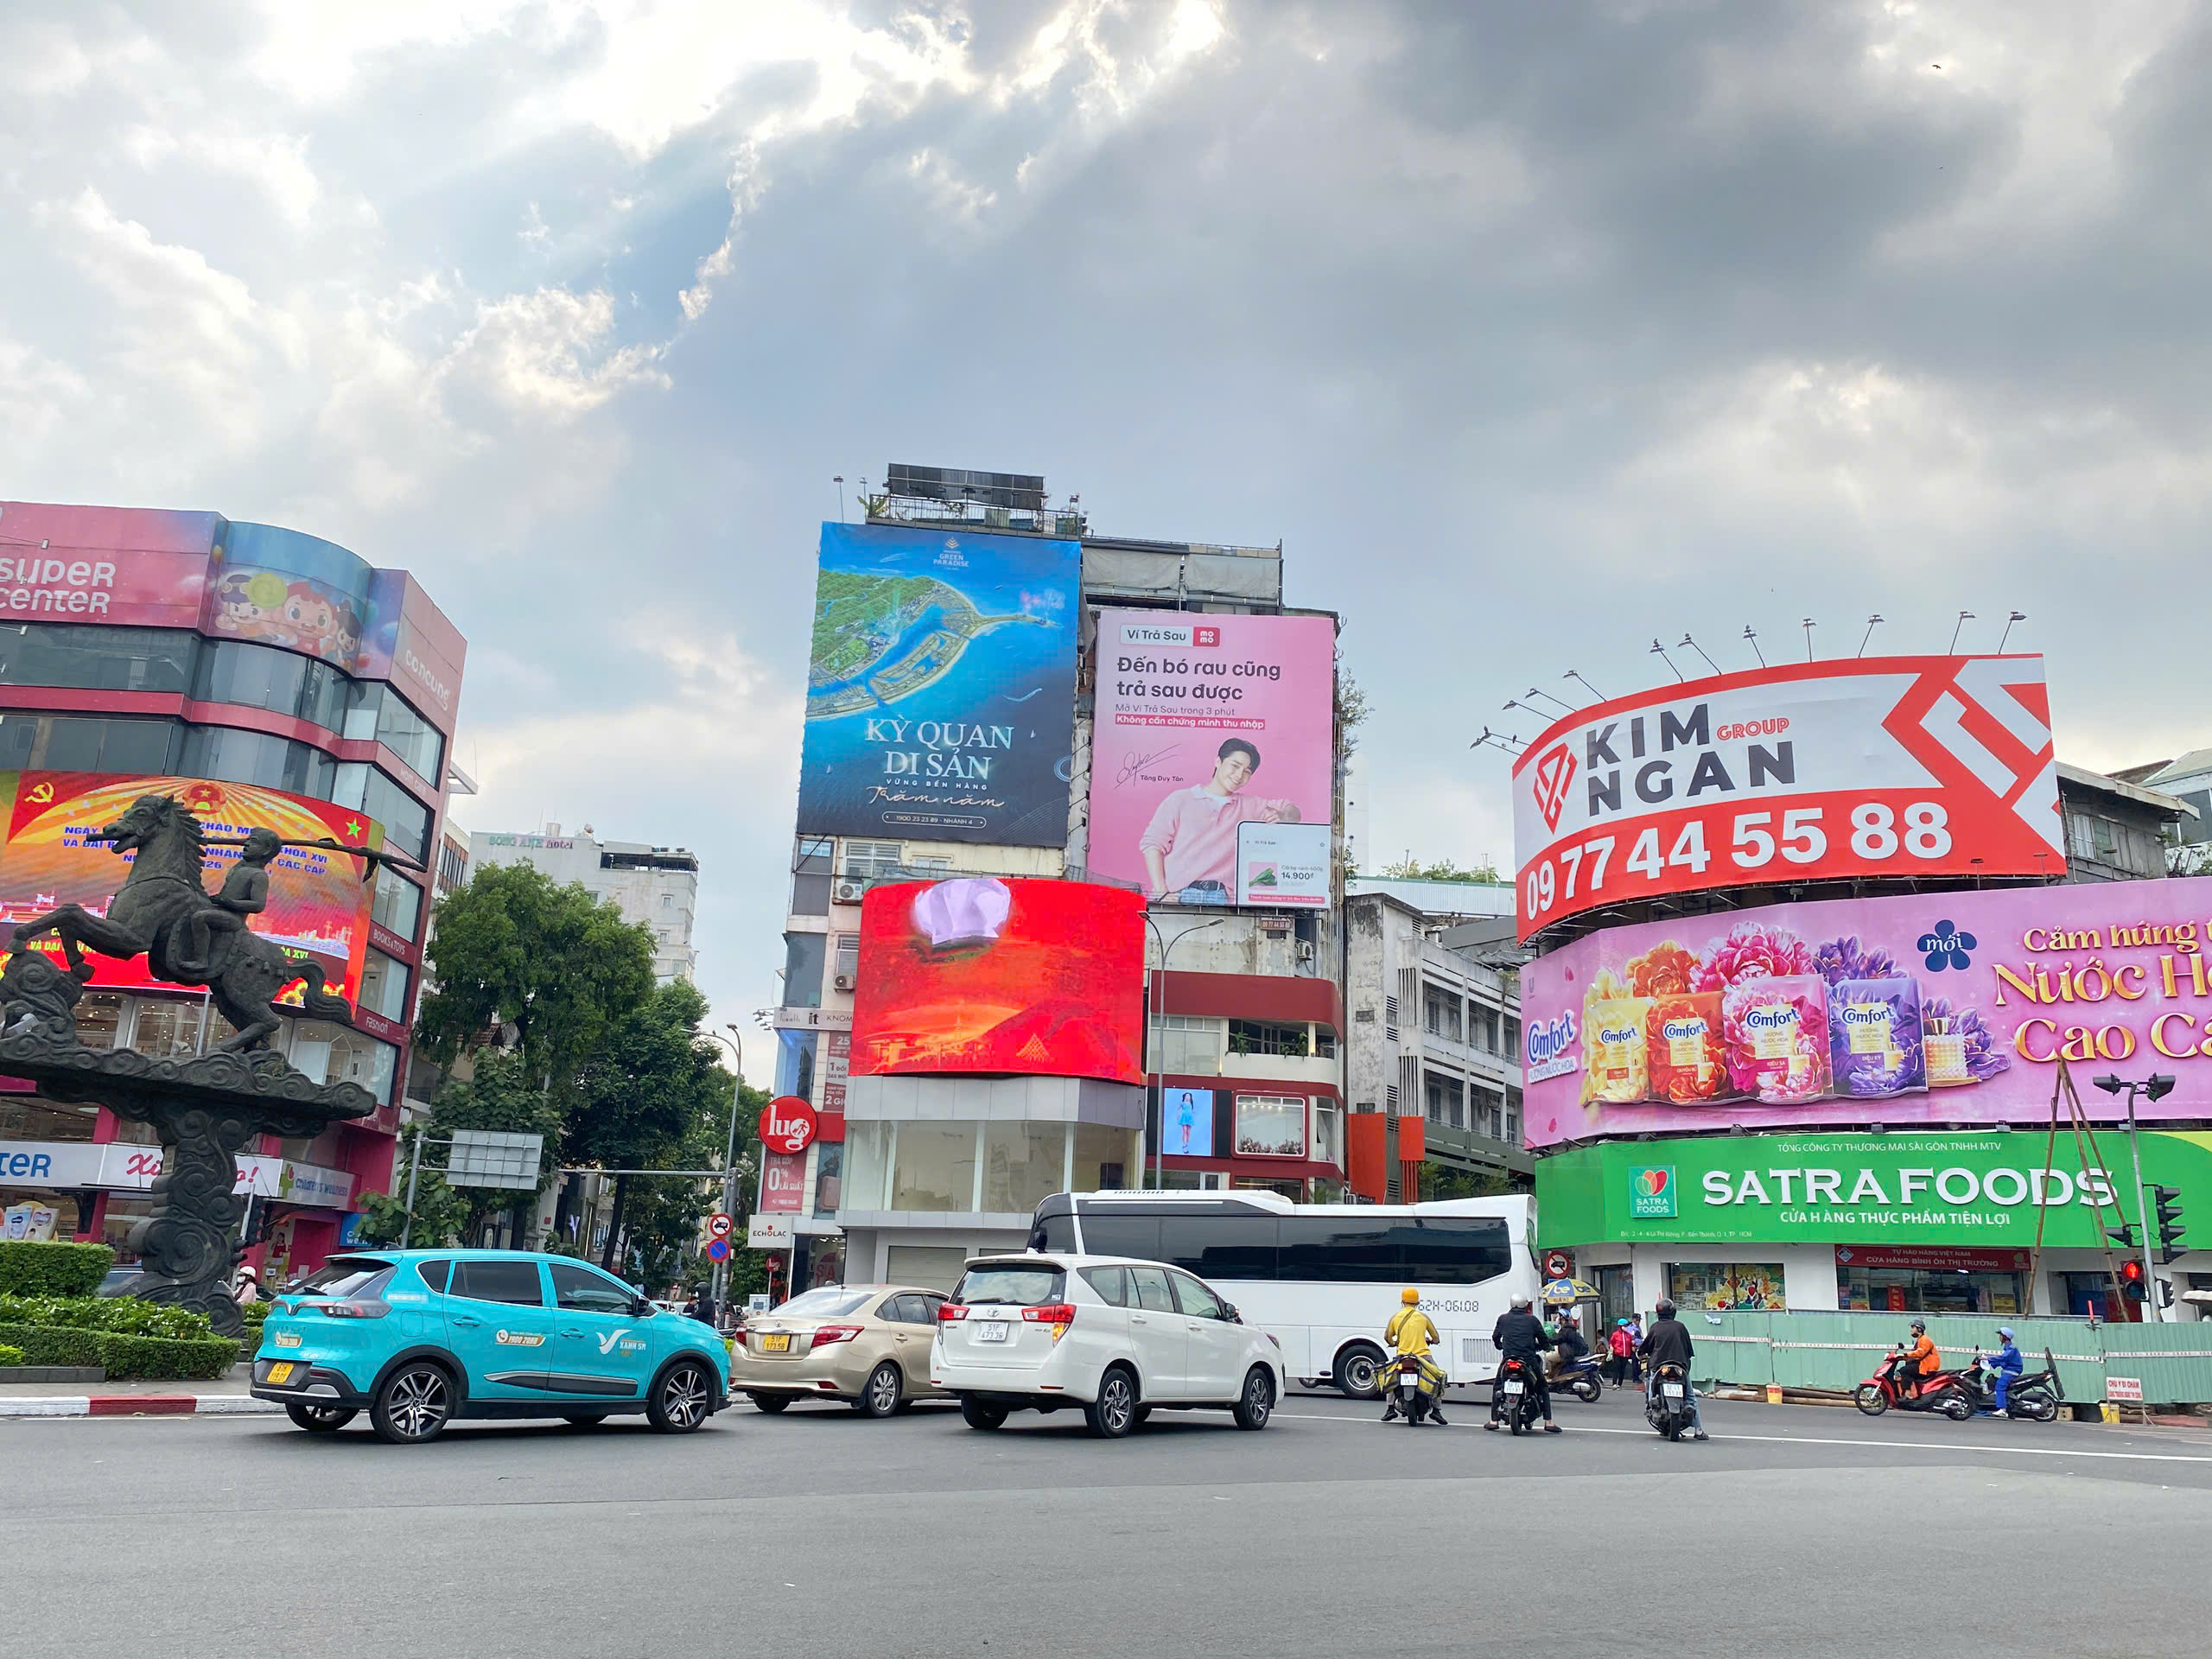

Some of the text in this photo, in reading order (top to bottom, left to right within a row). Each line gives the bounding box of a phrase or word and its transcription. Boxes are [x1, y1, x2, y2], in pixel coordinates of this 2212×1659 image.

[1128, 629, 1186, 641] Ví Trả Sau
[1117, 656, 1281, 681] Đến bó rau cũng
[1117, 680, 1243, 703] trả sau được
[1116, 703, 1130, 712] Mở
[1144, 704, 1158, 713] Trả
[1160, 705, 1178, 714] Sau
[1180, 707, 1204, 716] trong
[1214, 707, 1235, 717] phút
[864, 714, 1014, 750] KỲ QUAN
[1116, 715, 1147, 725] Không
[1148, 715, 1165, 725] cần
[1167, 717, 1196, 728] chứng
[1198, 718, 1221, 727] minh
[1240, 721, 1264, 730] nhập
[1586, 703, 1790, 771] KIM GROUP
[884, 747, 992, 779] DI SẢN
[956, 782, 988, 791] HÀNG
[1587, 741, 1796, 817] NGAN
[866, 785, 1005, 807] Trăm năm
[1527, 802, 1953, 920] 09 77 44 55 88
[1925, 932, 1963, 953] mới
[2024, 919, 2200, 954] Cảm hứng
[1991, 956, 2147, 1006] Nước
[808, 1013, 819, 1025] it
[1746, 1008, 1800, 1028] Comfort
[1842, 1006, 1896, 1025] Comfort
[1528, 1013, 1573, 1063] Comfort
[1601, 1027, 1637, 1044] Comfort
[1664, 1021, 1707, 1039] Comfort
[2015, 1018, 2137, 1063] Cao
[836, 1037, 850, 1046] 25
[830, 1062, 835, 1071] 1
[825, 1096, 832, 1105] 2
[767, 1105, 810, 1151] lug
[1802, 1141, 1830, 1153] CÔNG
[1832, 1143, 1843, 1152] TY
[1846, 1142, 1886, 1152] THƯƠNG
[1908, 1141, 1923, 1151] SÀI
[1925, 1141, 1948, 1151] GÒN
[1949, 1141, 1978, 1151] TNHH
[1980, 1141, 2001, 1150] MTV
[126, 1154, 162, 1176] Xi
[1702, 1166, 2118, 1206] SATRA FOODS
[1637, 1205, 1670, 1214] FOODS
[1780, 1208, 2011, 1228] CỬA HÀNG THỰC PHẨM TIỆN LỢI
